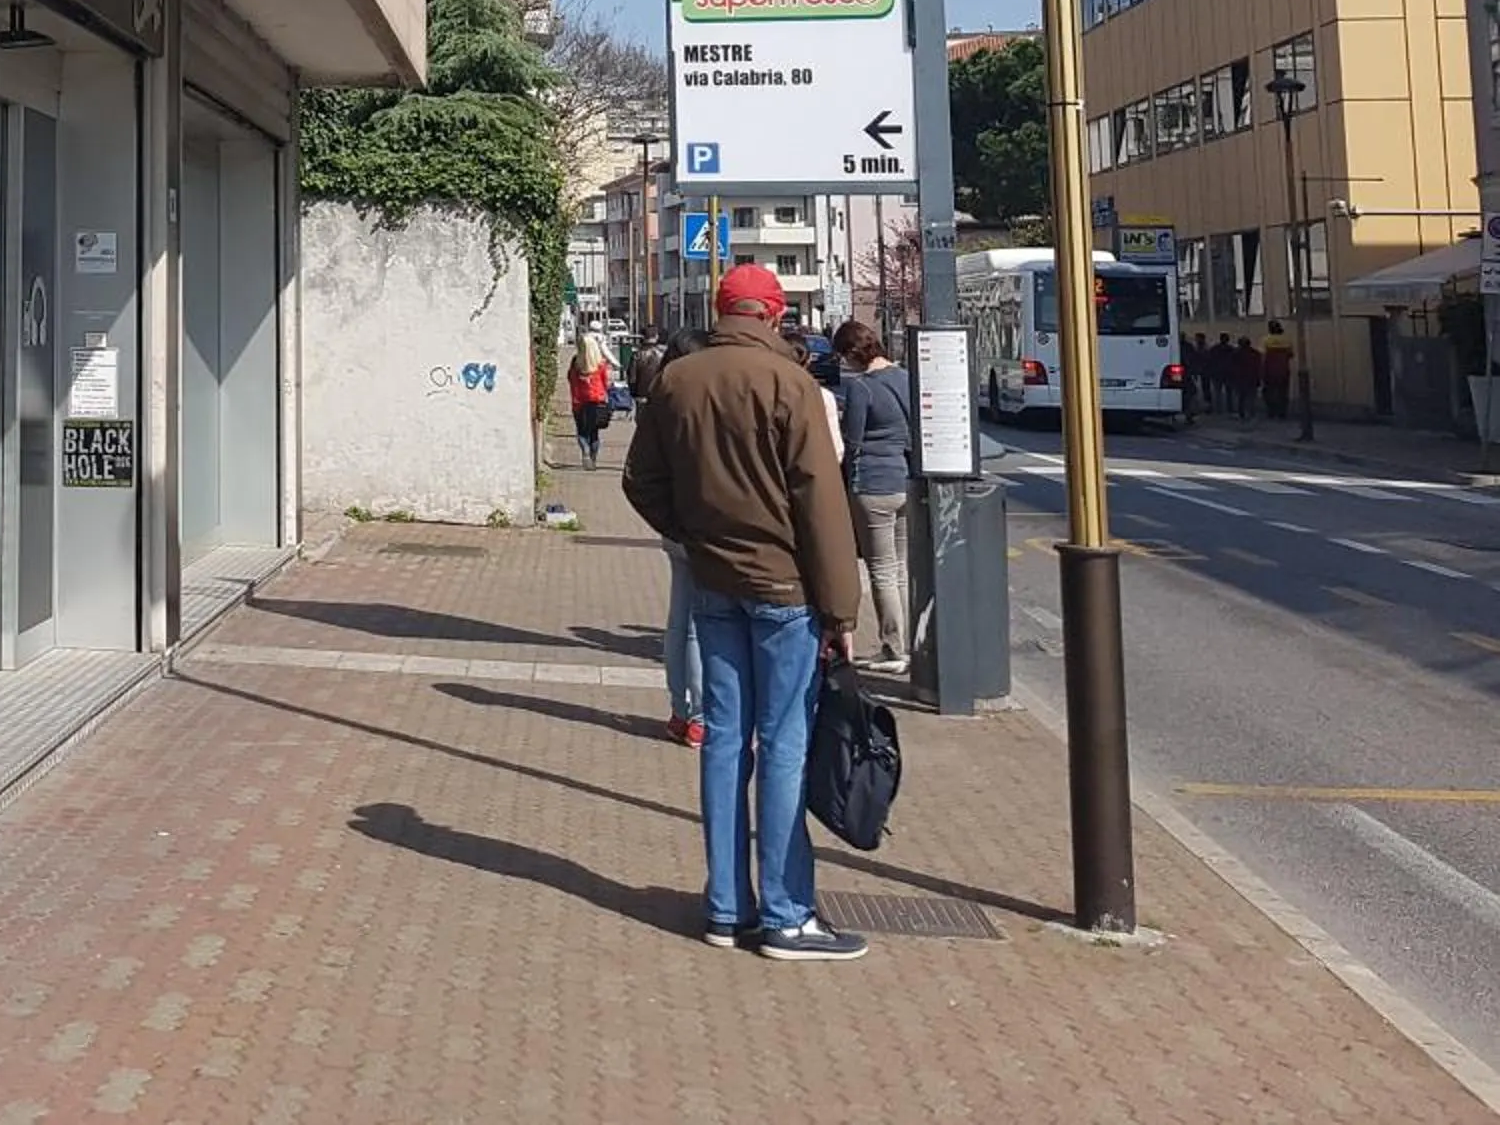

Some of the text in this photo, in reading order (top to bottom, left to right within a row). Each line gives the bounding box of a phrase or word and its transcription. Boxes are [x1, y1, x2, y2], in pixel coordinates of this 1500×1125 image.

[684, 44, 753, 63] MESTRE
[684, 68, 813, 87] via Calabria, 80
[692, 145, 713, 172] P
[843, 155, 904, 174] 5 min.
[65, 428, 131, 454] BLACK
[64, 454, 115, 480] HOLE
